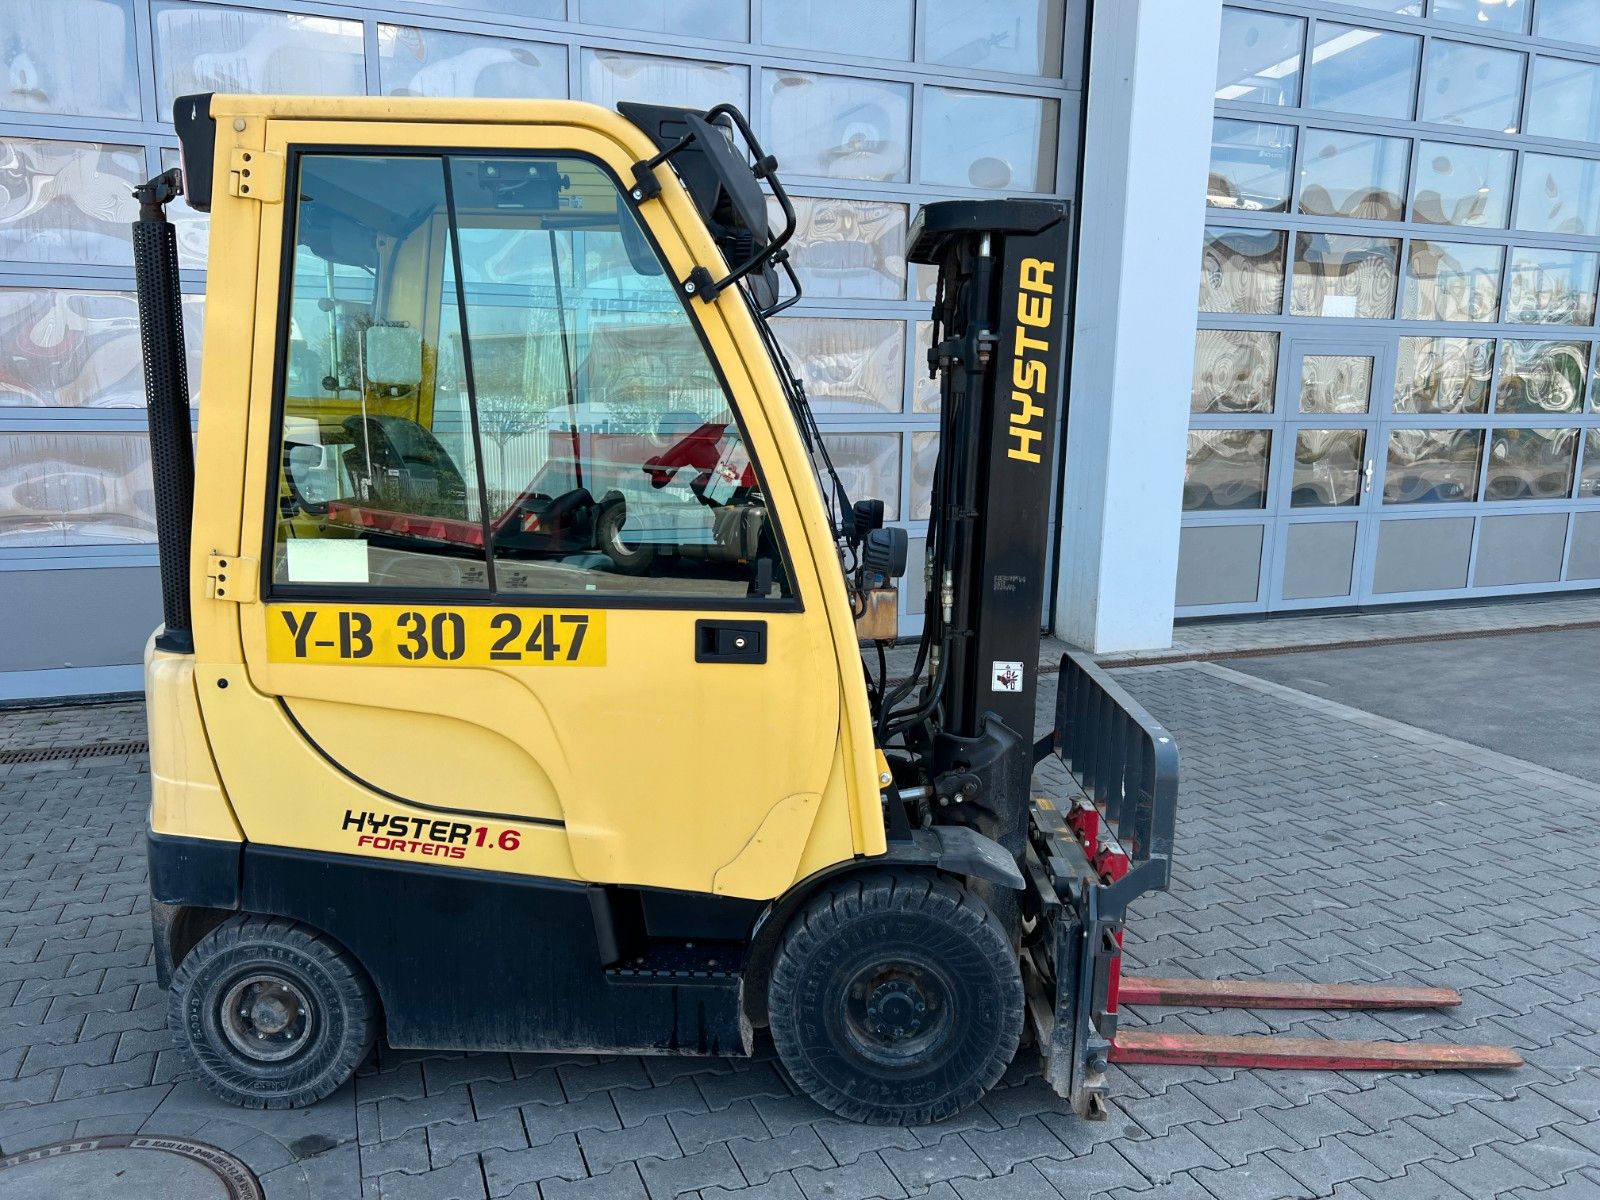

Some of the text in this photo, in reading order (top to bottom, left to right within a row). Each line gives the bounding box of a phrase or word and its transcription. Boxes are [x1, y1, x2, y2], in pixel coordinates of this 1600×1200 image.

[1007, 257, 1055, 464] HYSTER
[281, 610, 589, 661] Y-B 30 247
[342, 809, 522, 851] HYSTER 1.6
[357, 835, 467, 859] FORTENS
